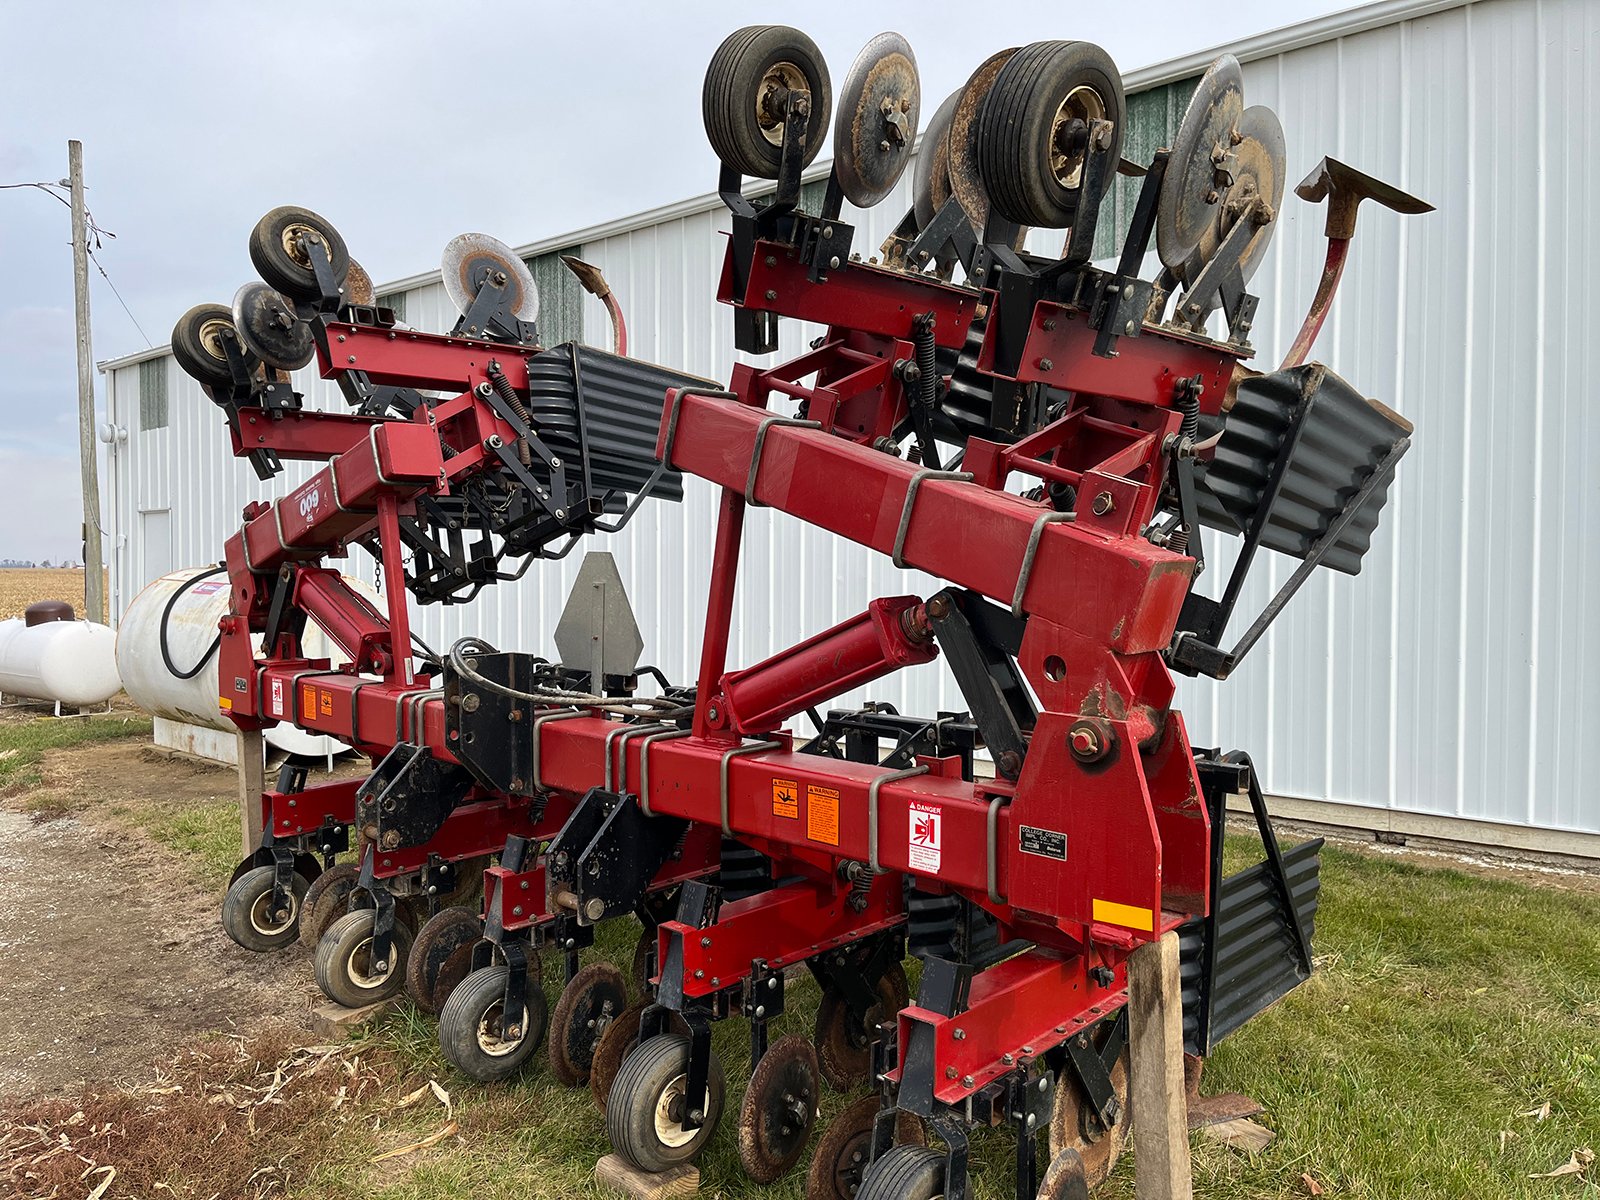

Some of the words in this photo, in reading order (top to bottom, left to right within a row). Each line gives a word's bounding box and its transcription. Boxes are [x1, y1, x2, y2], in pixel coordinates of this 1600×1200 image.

[300, 489, 319, 516] 600
[815, 787, 839, 797] WARNING
[917, 804, 941, 812] DANGER
